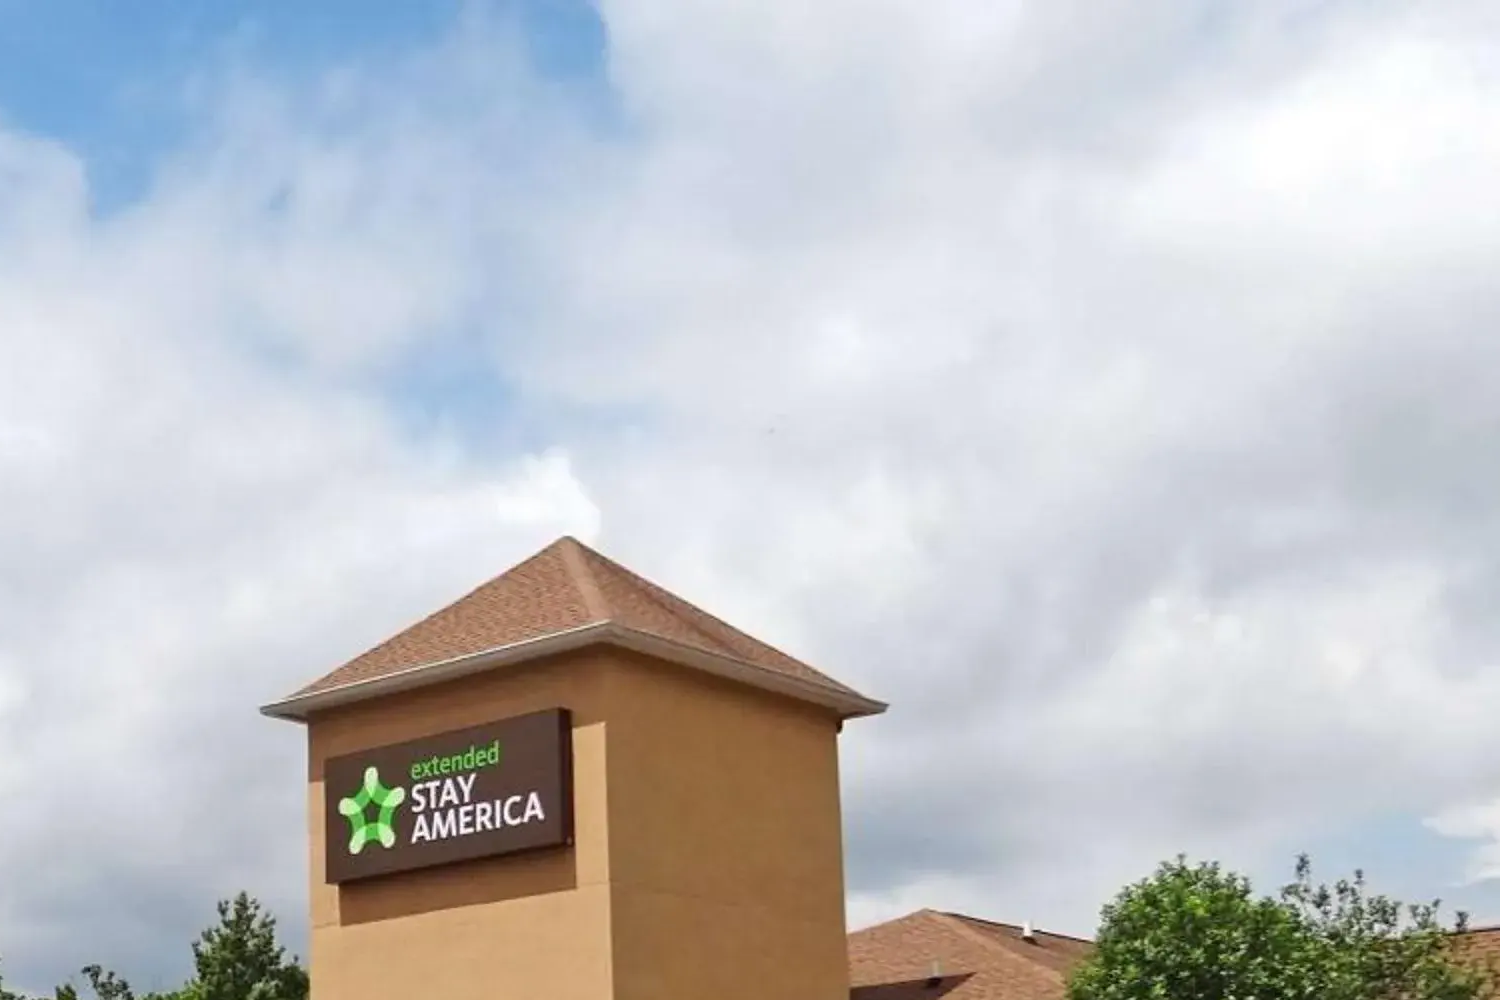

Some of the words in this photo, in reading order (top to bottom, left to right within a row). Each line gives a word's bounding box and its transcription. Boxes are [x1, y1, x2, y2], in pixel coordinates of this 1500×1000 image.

[411, 739, 501, 780] extended
[411, 773, 478, 813] STAY
[411, 791, 546, 844] AMERICA
